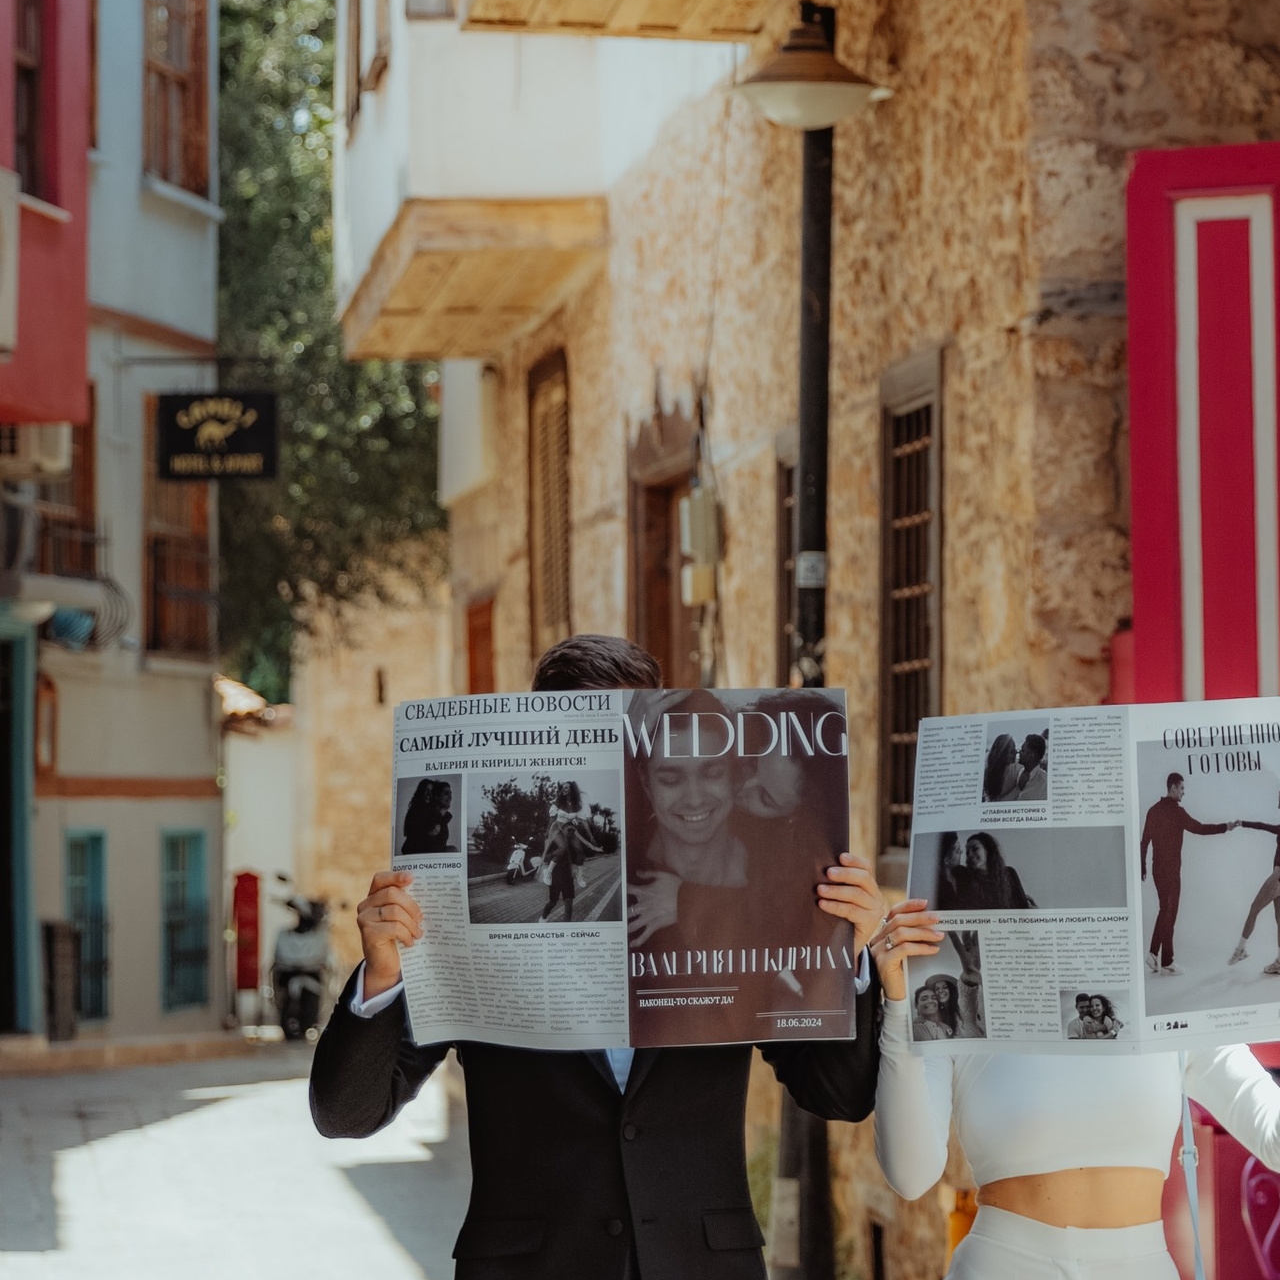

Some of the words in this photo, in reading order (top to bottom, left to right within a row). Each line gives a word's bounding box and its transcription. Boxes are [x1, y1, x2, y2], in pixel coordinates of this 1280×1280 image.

[405, 697, 511, 720] СВАДЕБНЫЕ
[516, 694, 612, 713] НОВОСТИ
[400, 730, 464, 753] САМЫЙ
[467, 726, 561, 748] ЛУЧШИЙ
[565, 728, 619, 748] ДЕНЬ
[622, 711, 848, 758] WEDDING
[1163, 722, 1280, 750] СОВЕРШЕННО
[425, 760, 468, 771] ВАЛЕРИЯ
[470, 760, 479, 769] И
[481, 758, 527, 768] КИРИЛЛ
[529, 756, 587, 767] ЖЕНЯТСЯ!
[1188, 750, 1261, 775] ГОТОВЫ
[419, 862, 462, 870] СЧАСТЛИВО
[570, 930, 600, 938] СЕЙЧАС
[639, 997, 687, 1008] НАКОНЕЦ-ТО
[688, 996, 720, 1006] СКАЖУТ
[720, 995, 734, 1005] ДА!
[776, 1018, 822, 1028] 18.06.2024
